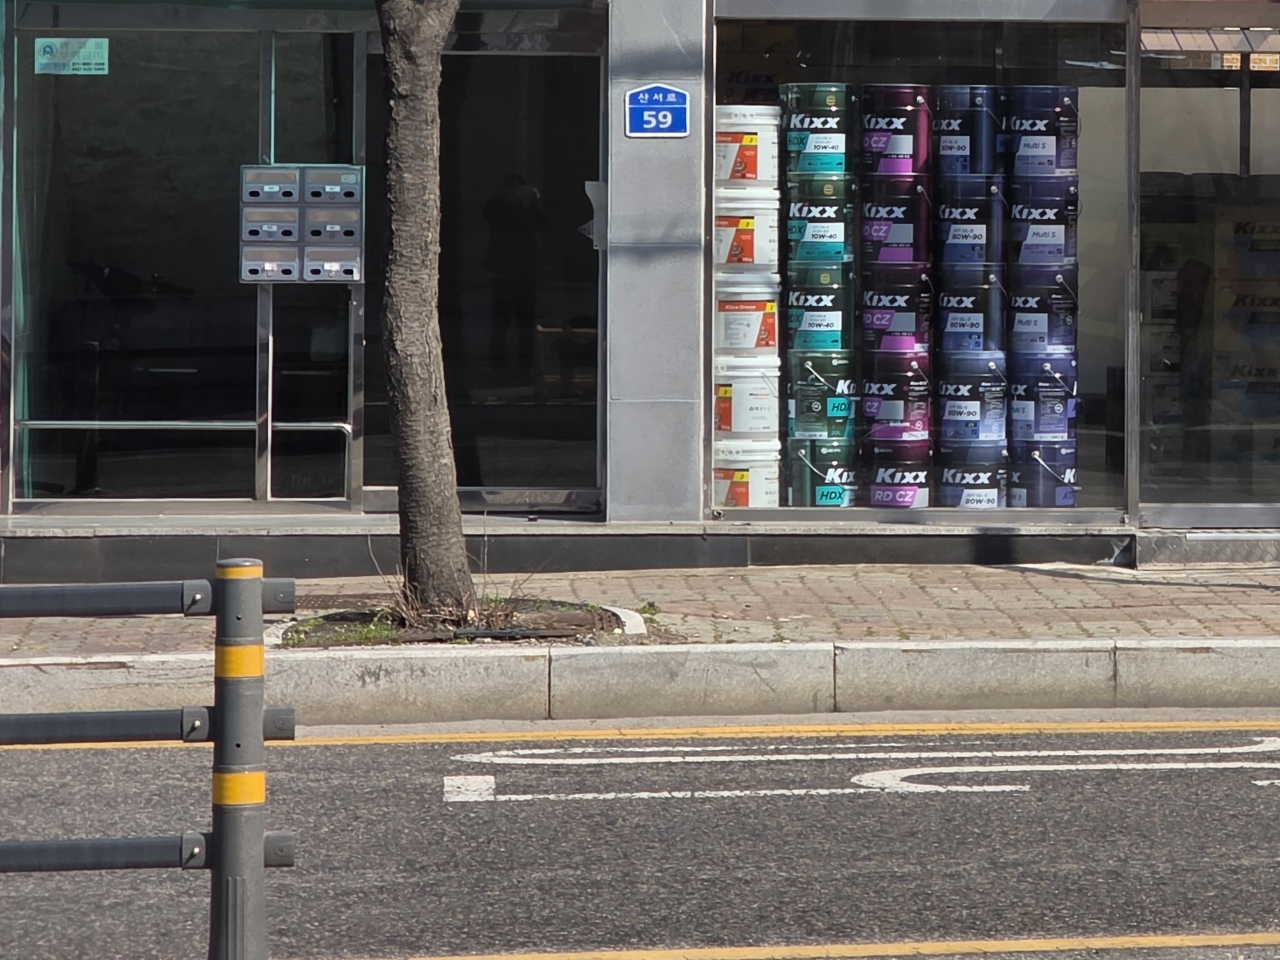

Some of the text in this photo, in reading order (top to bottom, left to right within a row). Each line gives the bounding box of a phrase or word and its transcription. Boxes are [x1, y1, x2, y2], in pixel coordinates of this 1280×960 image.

[638, 93, 677, 103] 산서로
[643, 111, 672, 129] 59
[790, 113, 840, 128] Kixx
[871, 136, 887, 148] CZ
[789, 202, 839, 218] Kixx
[1011, 204, 1059, 220] Kixx
[871, 226, 888, 237] CZ
[952, 233, 983, 241] 80W-90
[1032, 231, 1050, 239] Multi
[788, 291, 836, 307] Kixx
[863, 291, 910, 308] Kixx
[873, 314, 891, 325] CZ
[1230, 364, 1279, 377] Kixx
[831, 402, 851, 412] HDX
[865, 401, 879, 412] CZ
[875, 468, 928, 483] Kixx
[942, 468, 992, 484] Kixx
[820, 491, 844, 500] HDX
[874, 490, 915, 501] RD CZ
